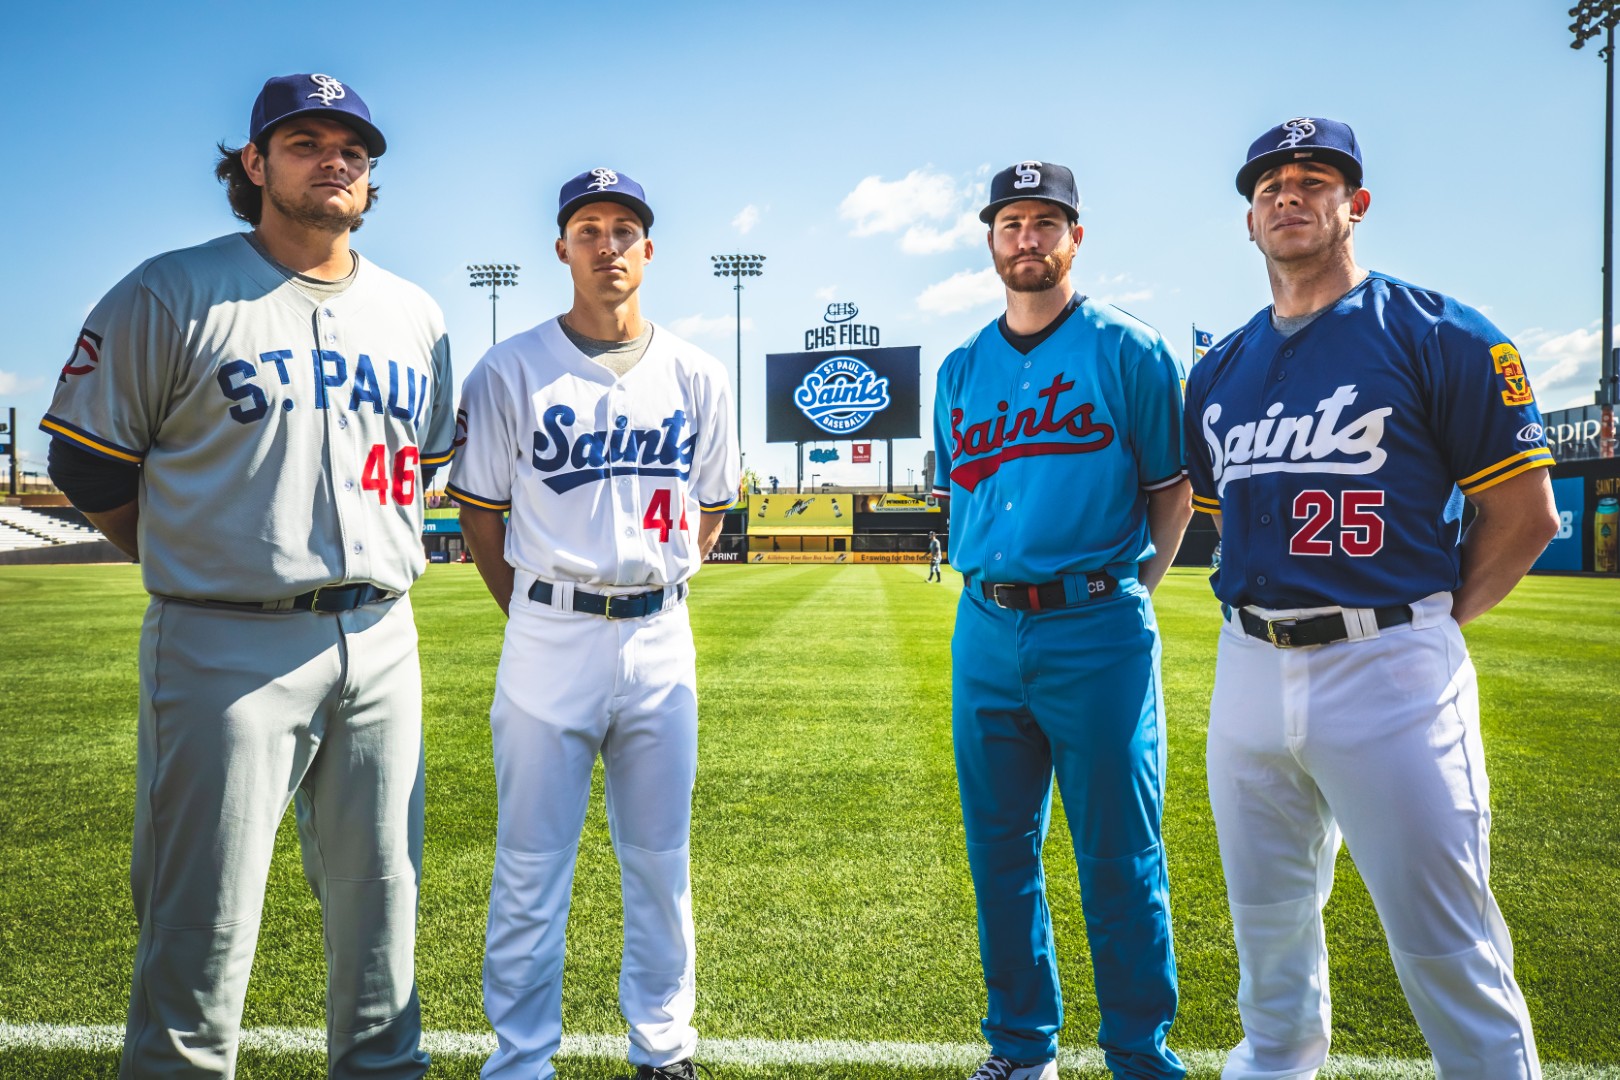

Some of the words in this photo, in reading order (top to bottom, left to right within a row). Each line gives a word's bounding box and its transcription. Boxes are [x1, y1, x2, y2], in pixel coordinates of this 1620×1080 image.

[827, 302, 855, 316] CHS
[804, 325, 836, 351] CHS
[839, 323, 880, 347] FIELD
[836, 360, 860, 374] PAUL
[797, 373, 888, 415] Saints
[822, 413, 866, 430] BASEBALL
[1202, 384, 1393, 482] Saints
[361, 443, 420, 505] 46
[1289, 489, 1385, 557] 25
[712, 552, 739, 561] PRINT
[1087, 582, 1106, 593] CB
